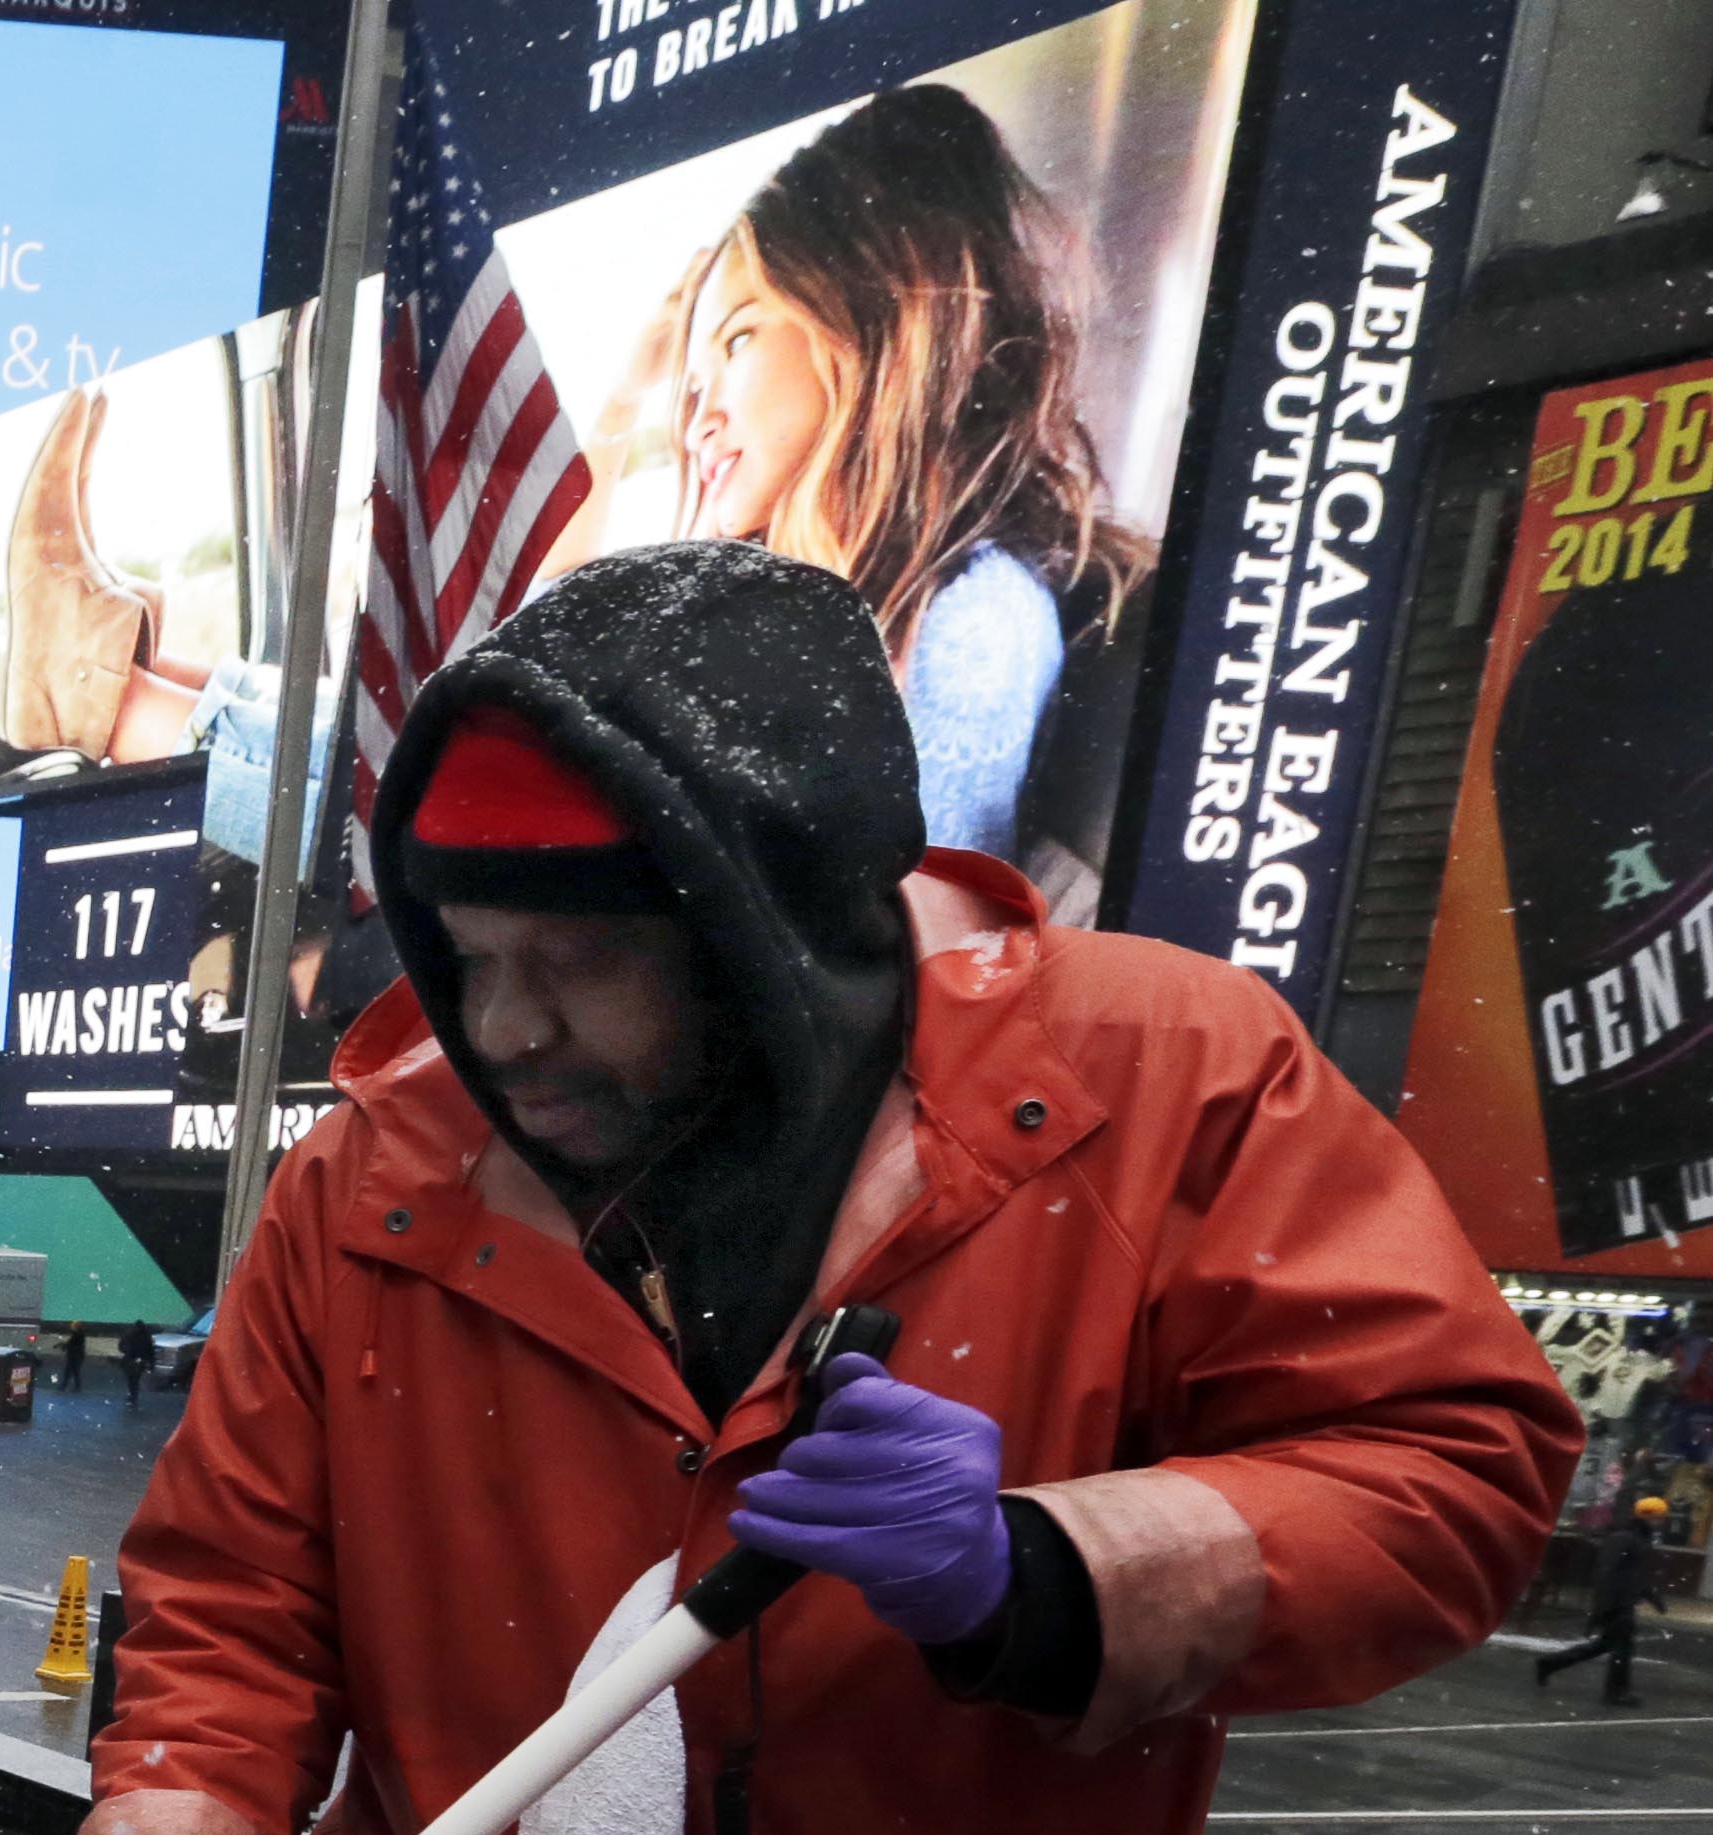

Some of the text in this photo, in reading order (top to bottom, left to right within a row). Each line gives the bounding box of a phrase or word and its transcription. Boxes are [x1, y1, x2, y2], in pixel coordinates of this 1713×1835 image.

[588, 0, 798, 113] TO BREAK
[2, 323, 50, 390] &
[1282, 83, 1458, 704] AMERICAN
[1182, 300, 1334, 864] OUTFITTERS
[1537, 505, 1695, 594] 2014
[1599, 839, 1674, 911] A
[73, 887, 156, 960] 117
[18, 981, 191, 1056] WASHES
